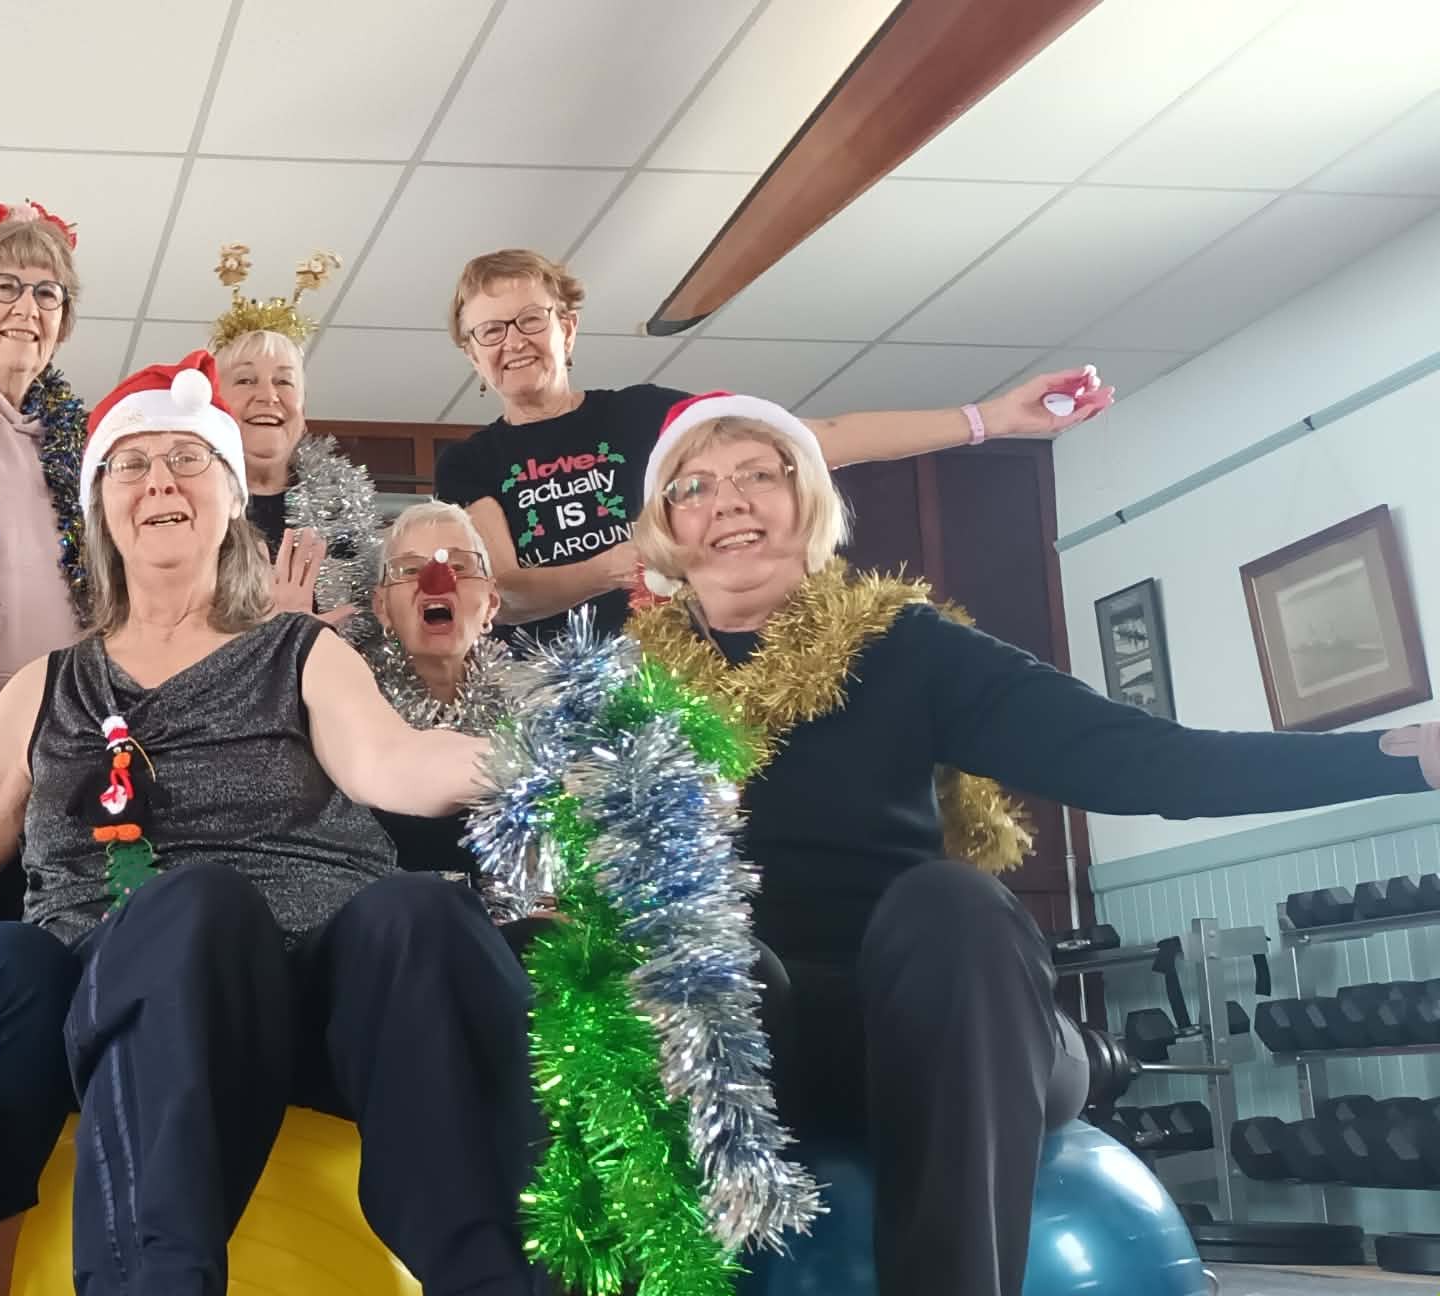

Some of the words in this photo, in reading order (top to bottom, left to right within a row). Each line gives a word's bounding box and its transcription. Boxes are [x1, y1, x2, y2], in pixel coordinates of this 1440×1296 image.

[527, 454, 596, 480] love
[518, 469, 615, 508] actually
[556, 502, 586, 529] IS
[552, 521, 636, 560] AROUN
